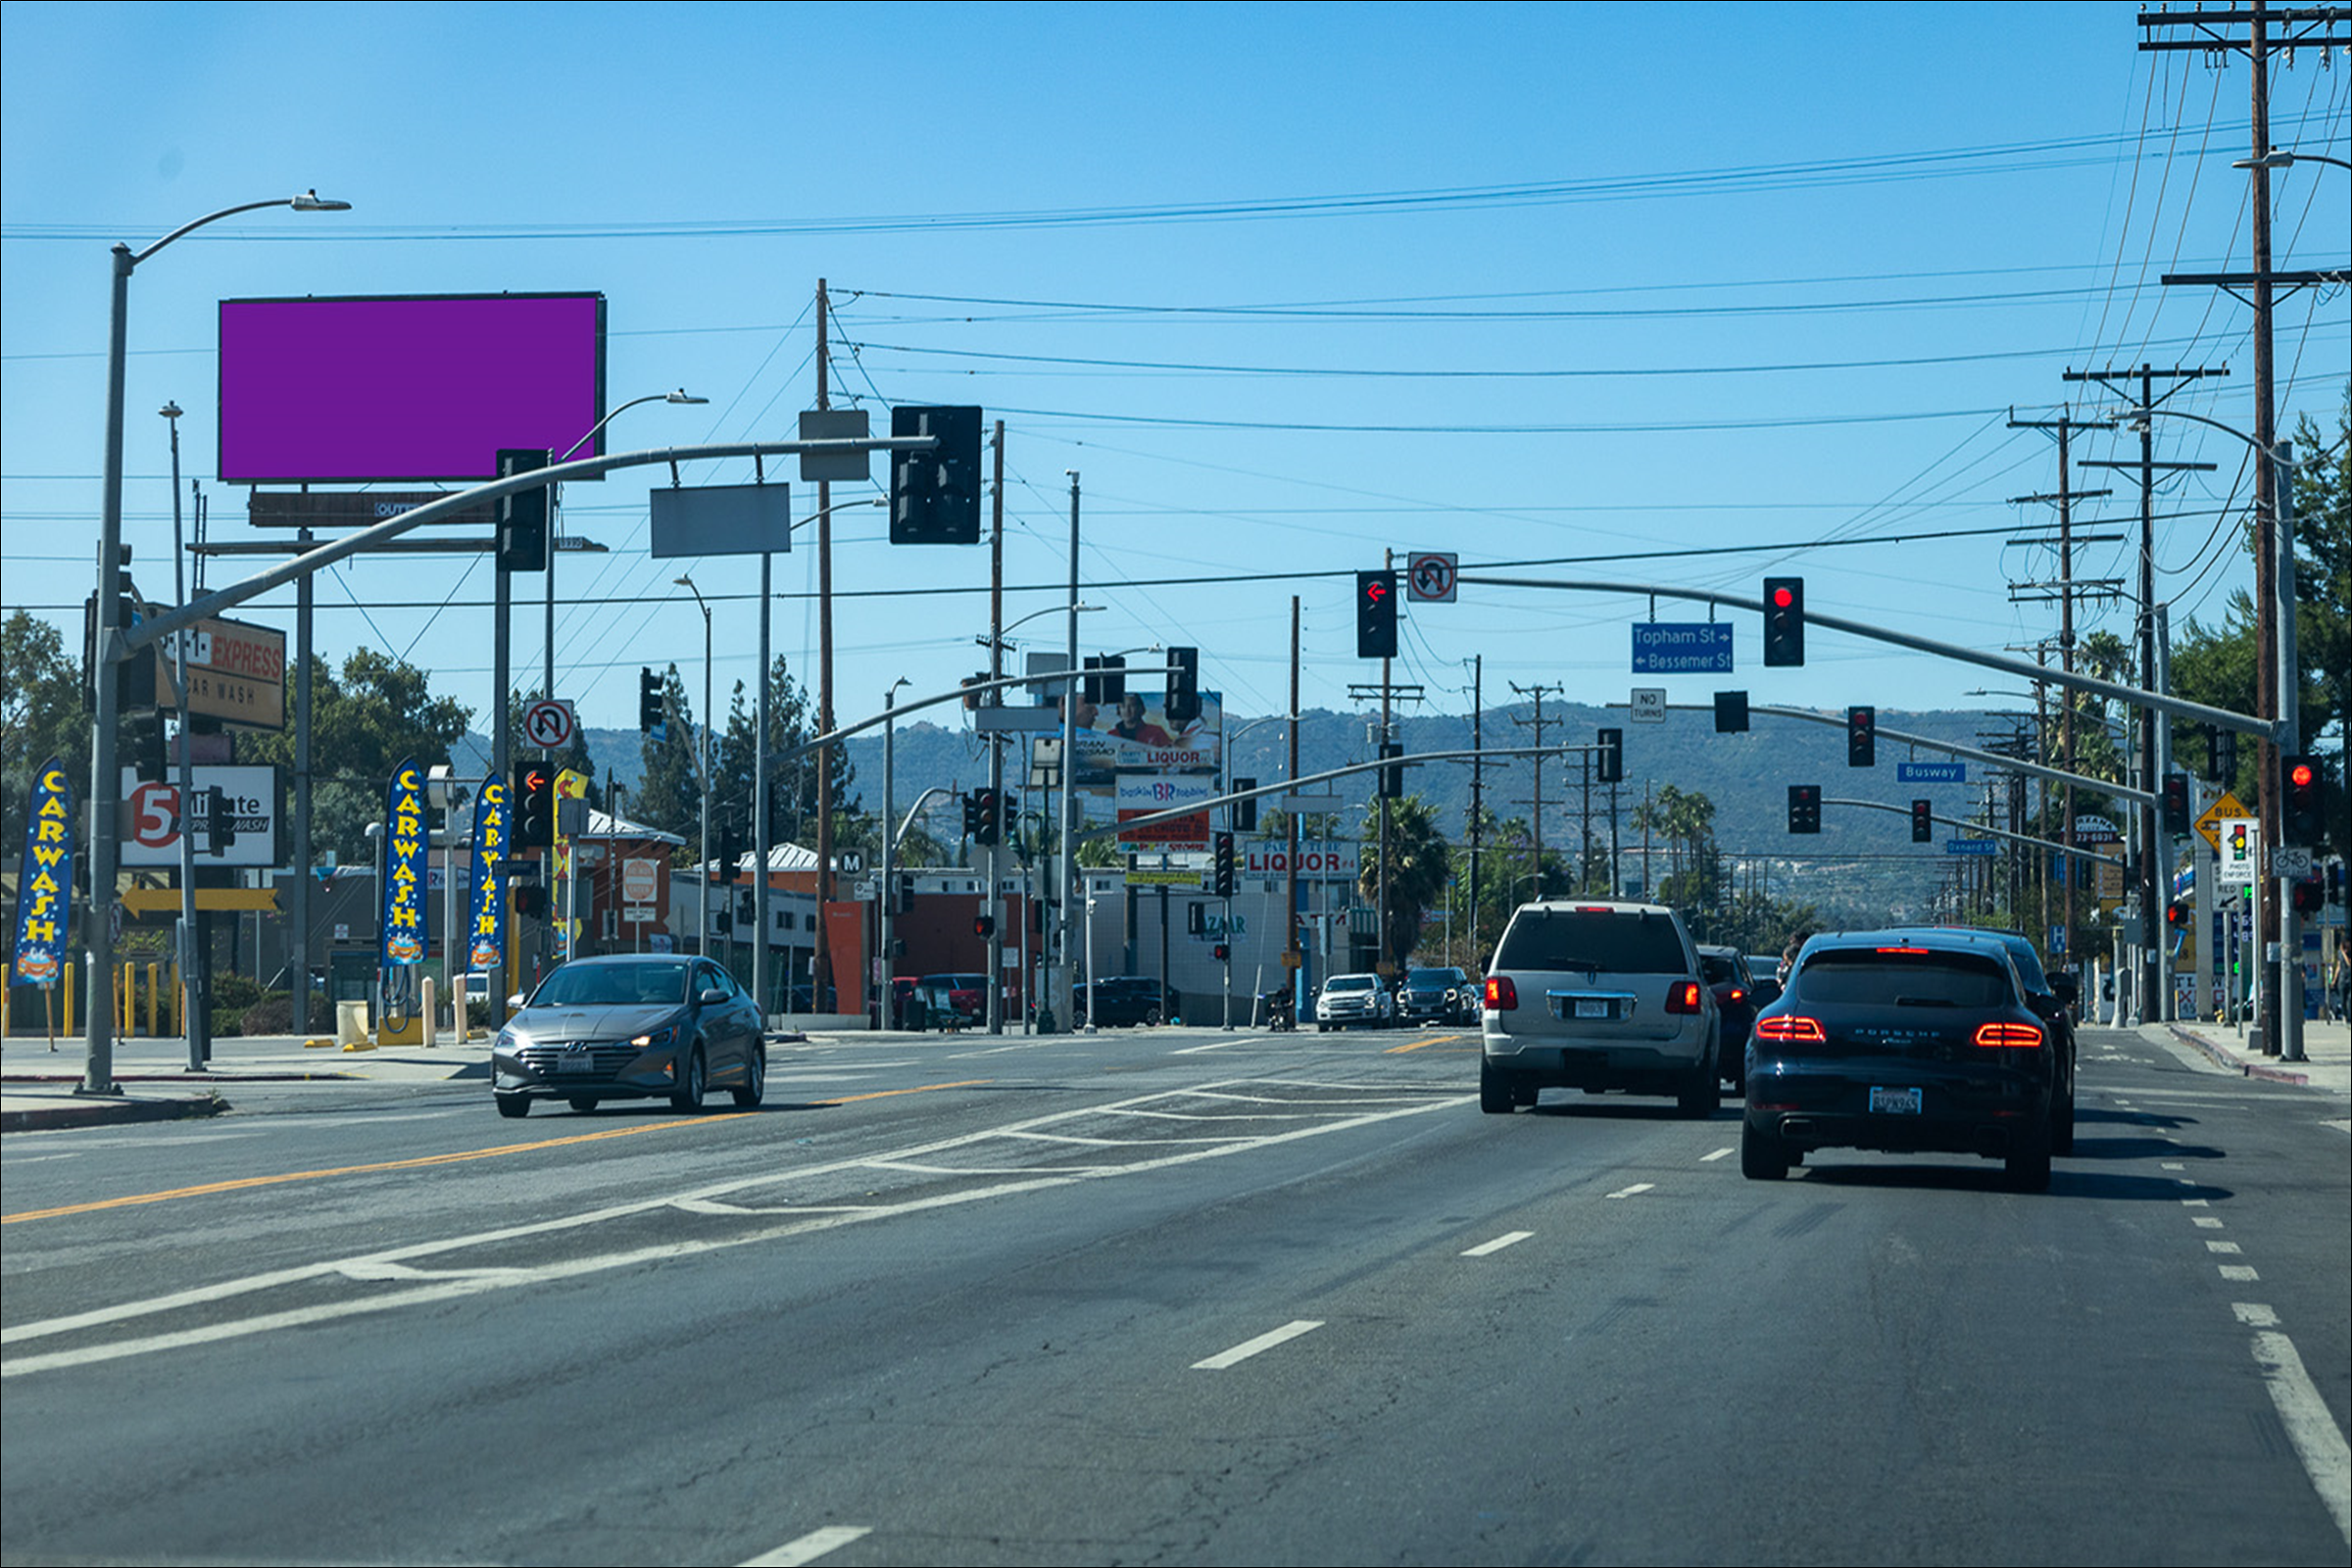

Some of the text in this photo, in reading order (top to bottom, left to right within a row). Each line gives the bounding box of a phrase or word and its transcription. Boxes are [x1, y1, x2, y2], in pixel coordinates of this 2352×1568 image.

[1635, 627, 1716, 648] Topham St
[212, 636, 281, 679] EXPRESS
[1648, 652, 1732, 668] Bessemer St
[218, 682, 255, 706] WASH
[1640, 693, 1657, 706] NO
[1634, 708, 1663, 718] TURNS
[1147, 752, 1200, 764] LIQUOR
[1905, 765, 1957, 780] Busway
[139, 789, 172, 840] 5
[2215, 807, 2242, 817] BUS
[844, 855, 859, 871] M
[2218, 885, 2236, 894] RED
